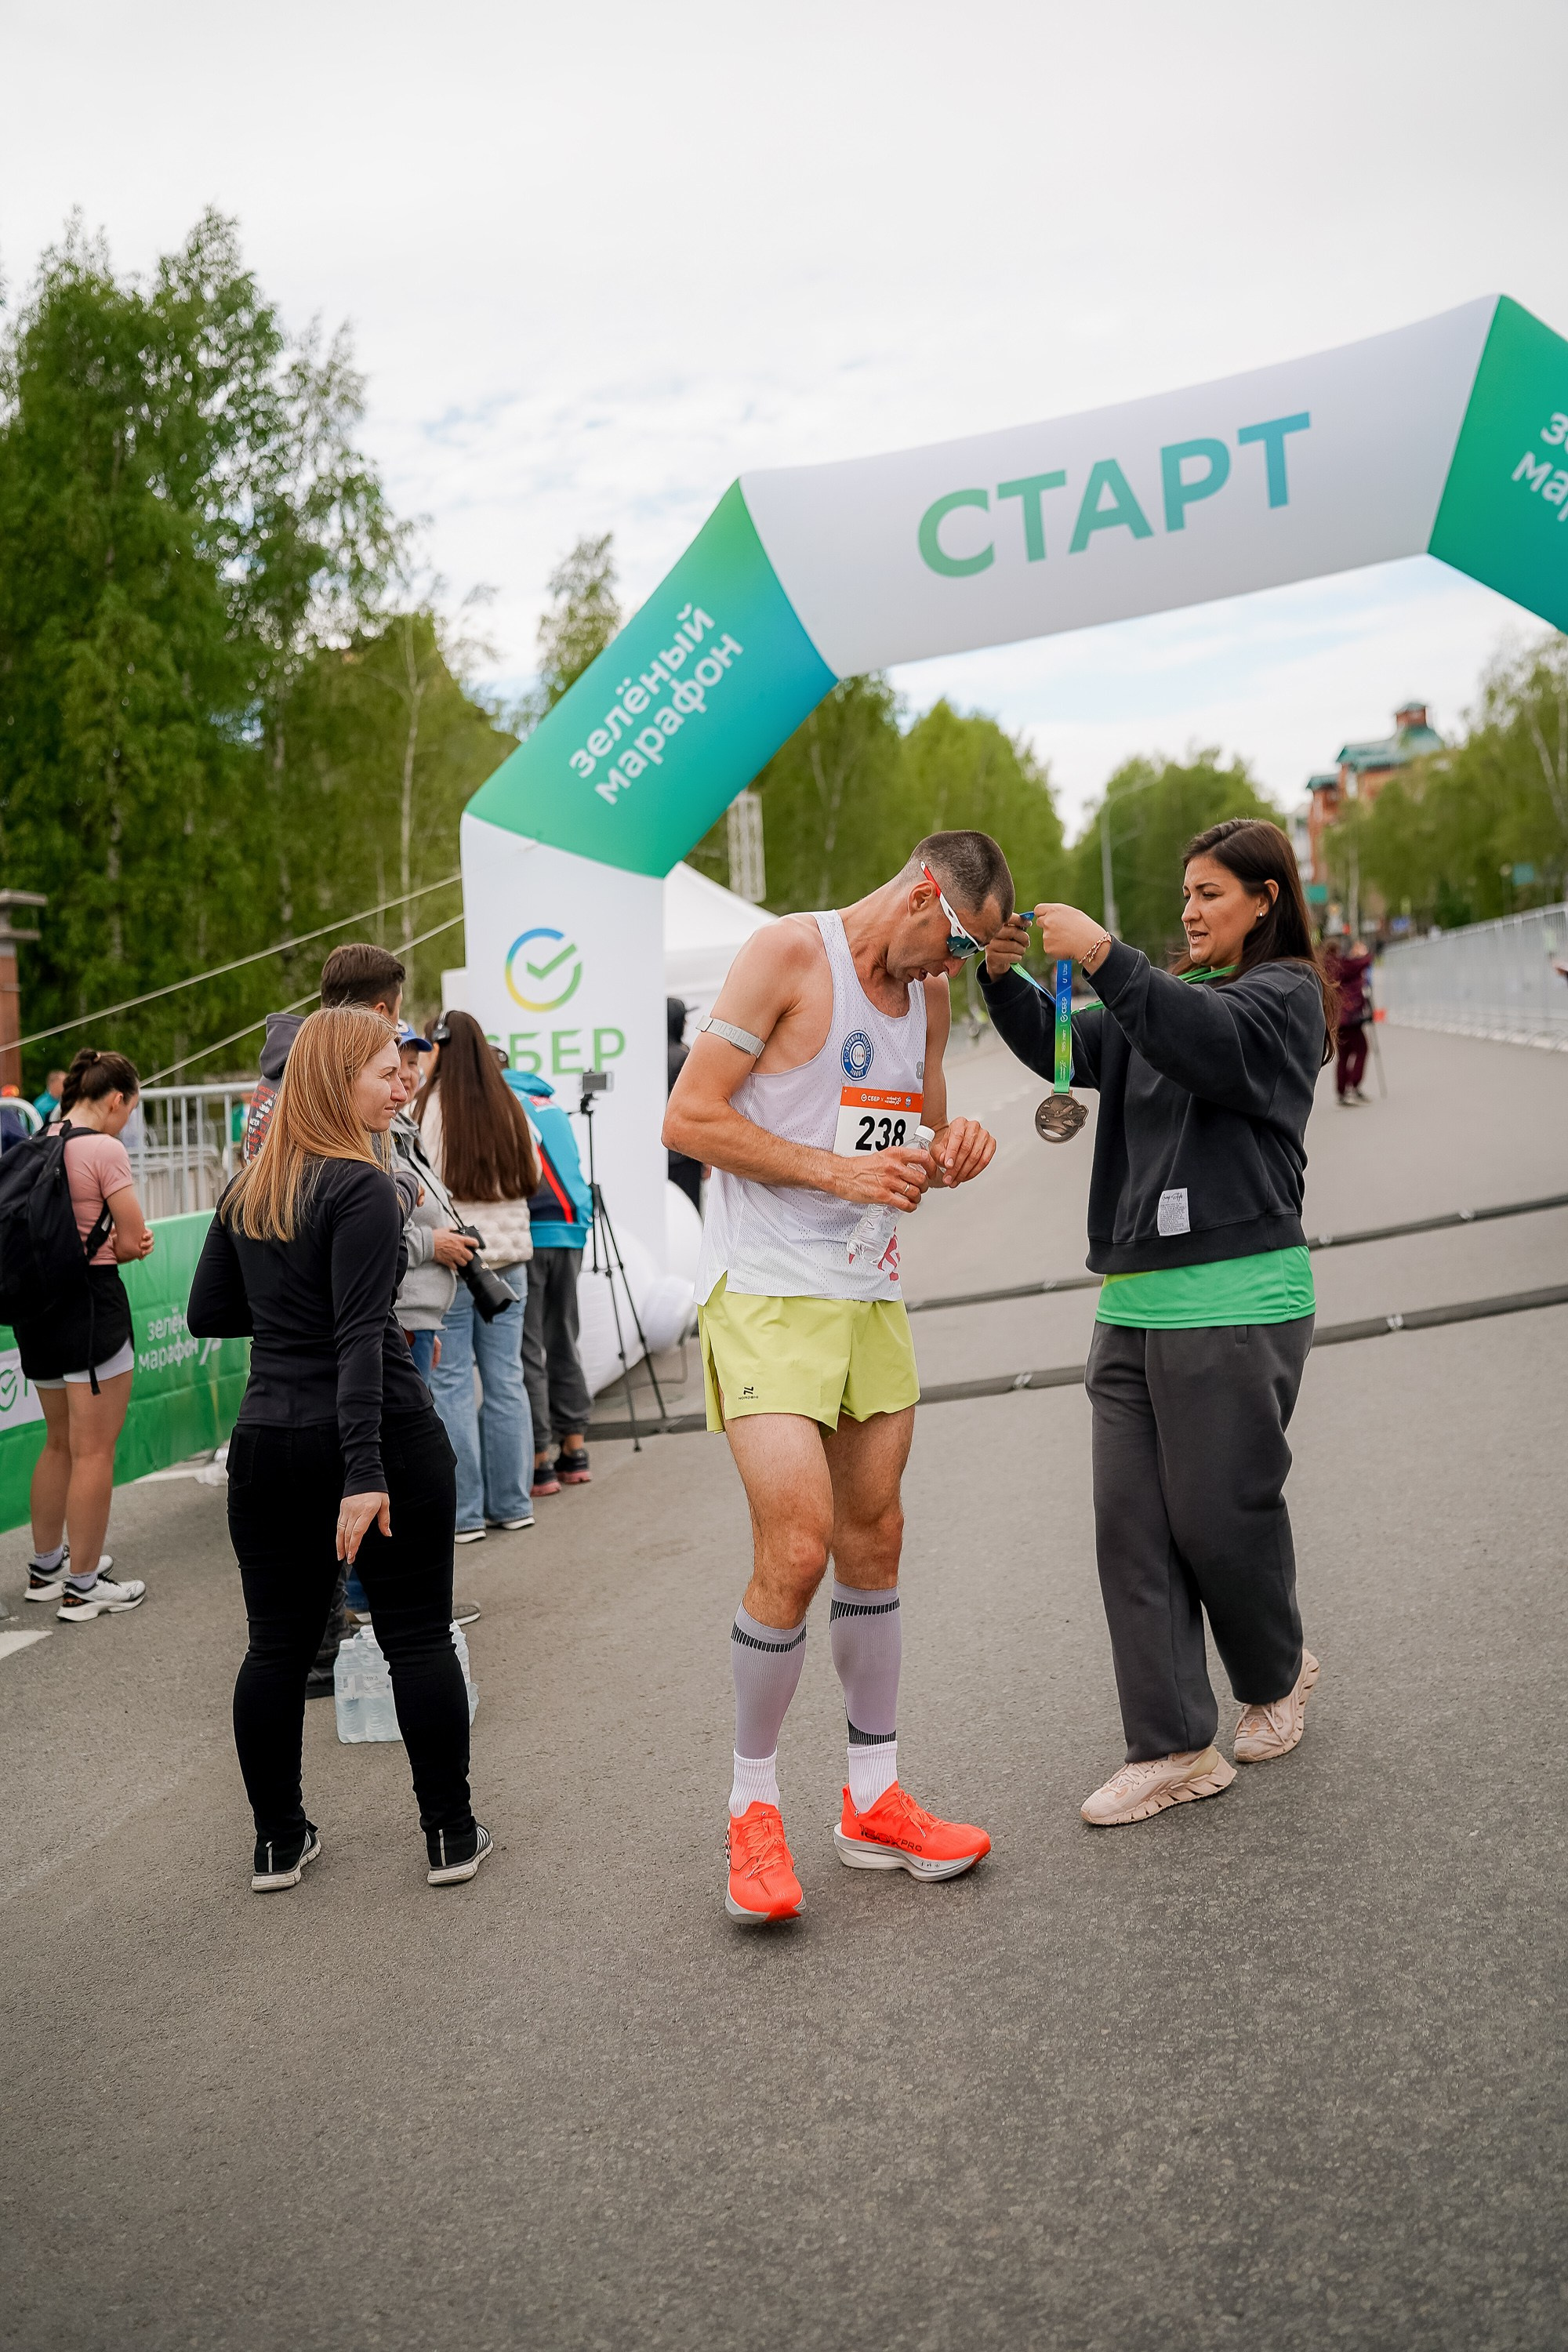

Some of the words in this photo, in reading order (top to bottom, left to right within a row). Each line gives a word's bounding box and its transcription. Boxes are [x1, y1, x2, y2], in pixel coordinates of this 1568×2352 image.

[917, 412, 1311, 579] СТАРТ
[1511, 450, 1568, 523] ма
[569, 603, 715, 779] зелёный
[594, 633, 743, 806] марафон
[855, 1116, 906, 1151] 238
[138, 1334, 199, 1374] марафон
